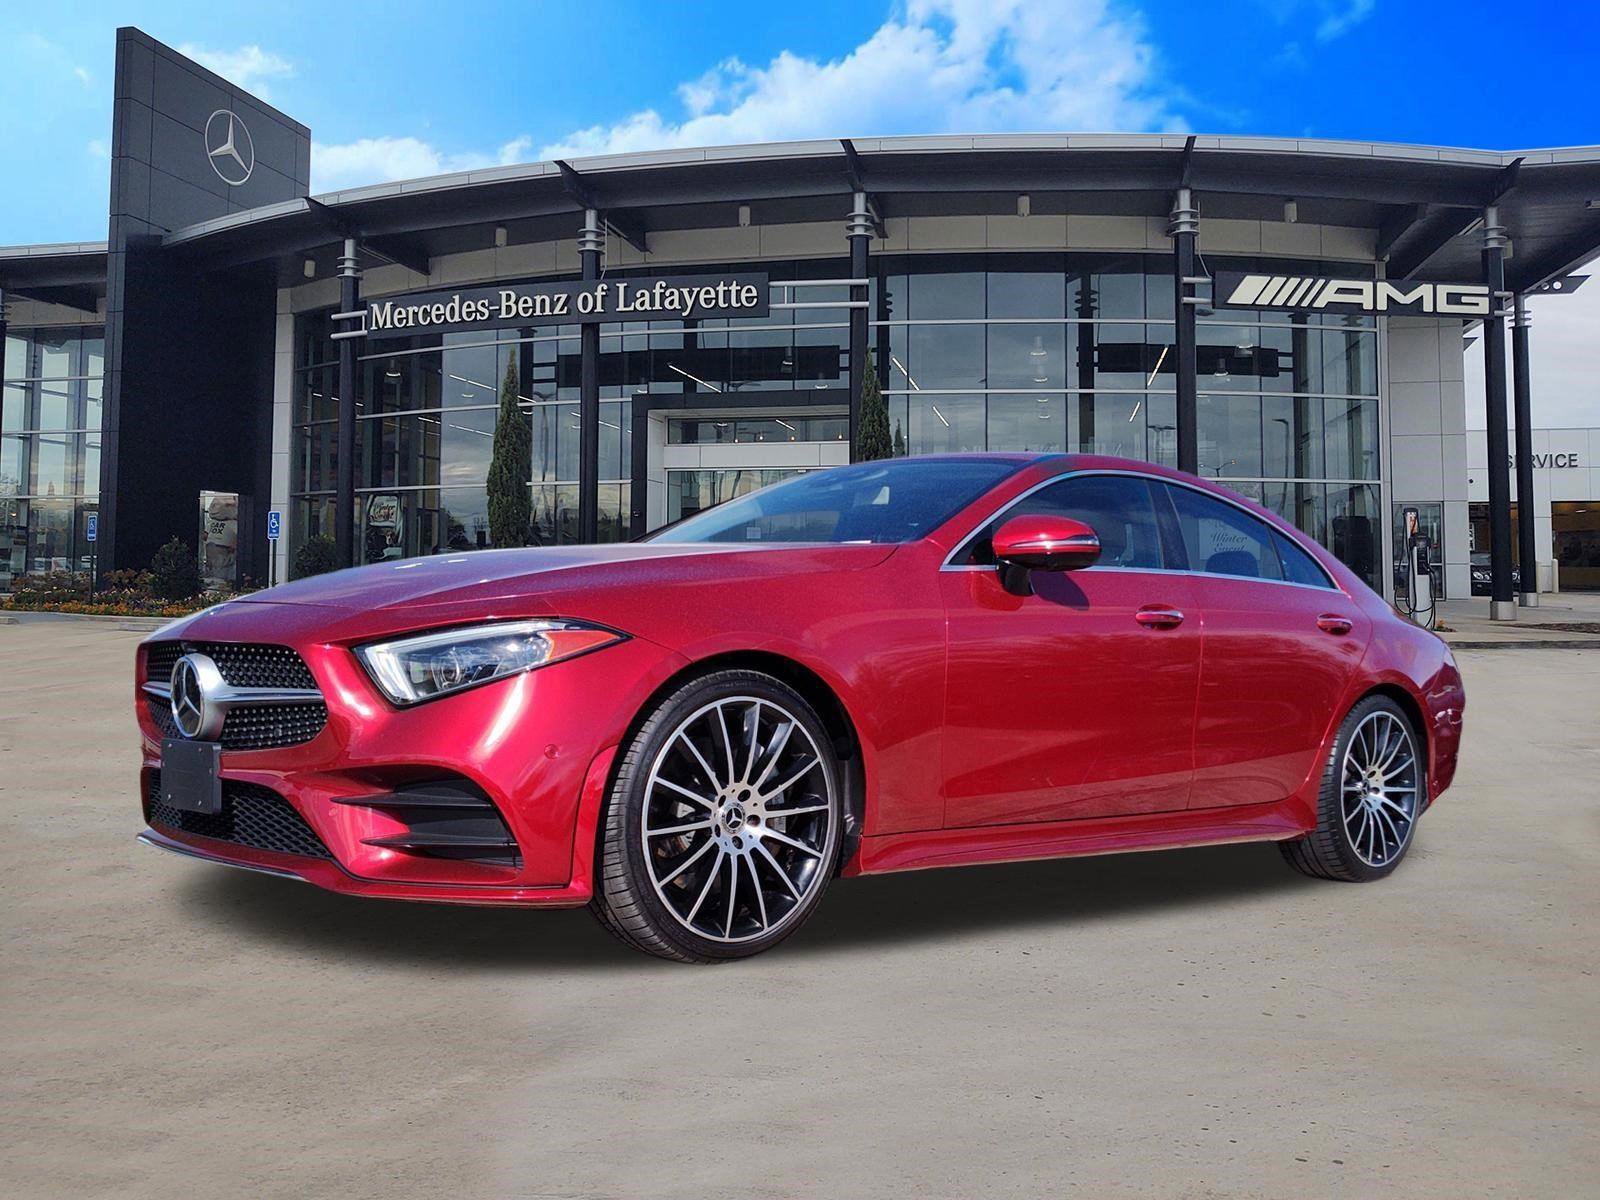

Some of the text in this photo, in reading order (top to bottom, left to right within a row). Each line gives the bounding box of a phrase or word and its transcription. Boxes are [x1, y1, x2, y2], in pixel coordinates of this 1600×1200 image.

[370, 280, 758, 330] Mercedes-Benz of Lafayette
[1312, 279, 1489, 314] AMG
